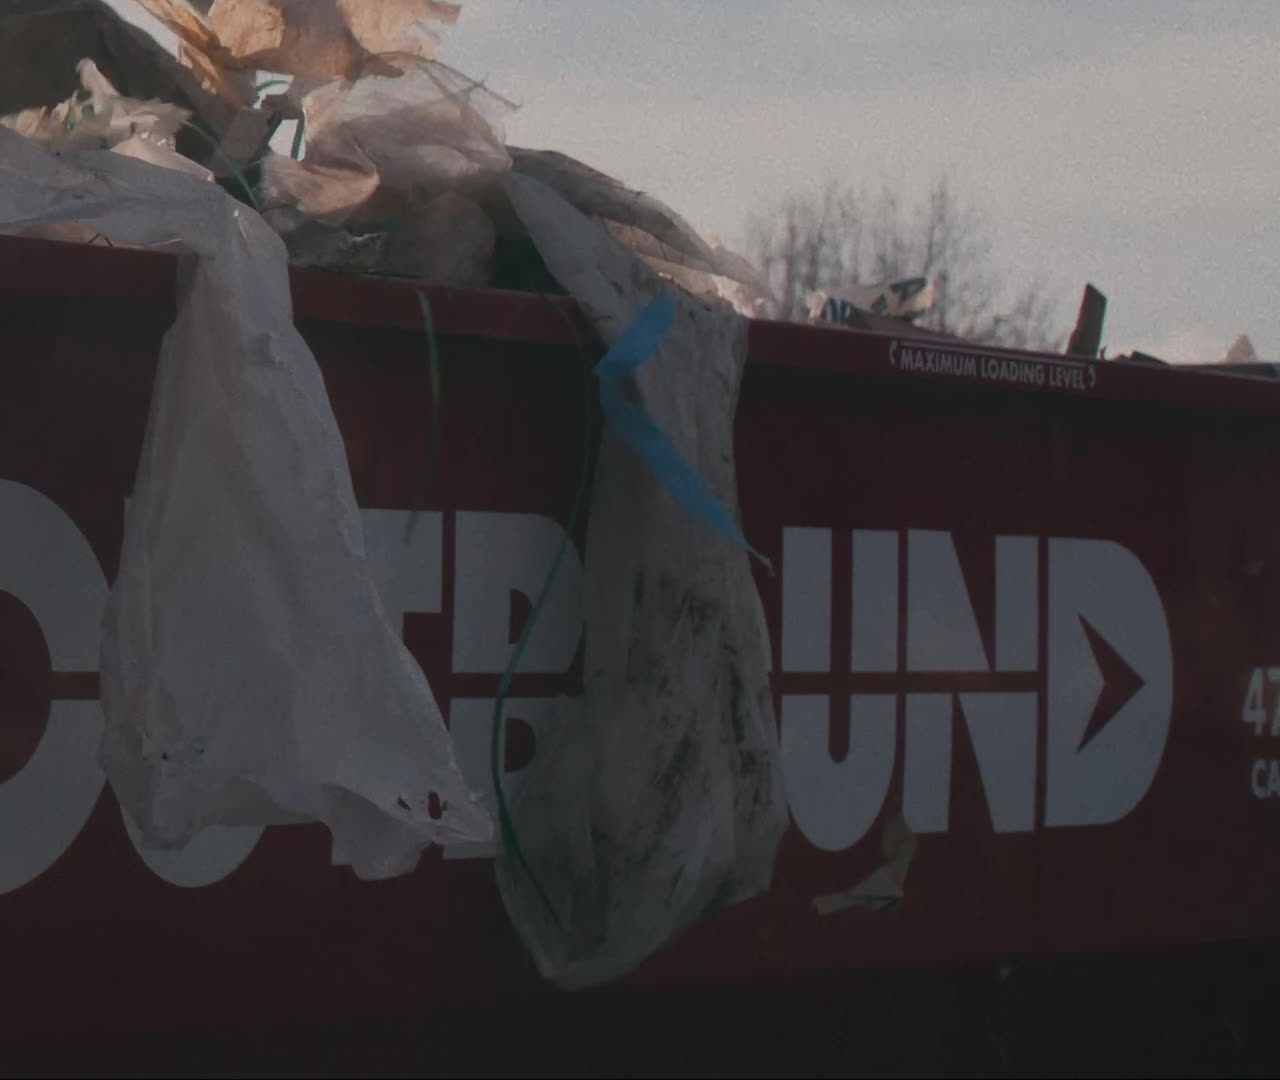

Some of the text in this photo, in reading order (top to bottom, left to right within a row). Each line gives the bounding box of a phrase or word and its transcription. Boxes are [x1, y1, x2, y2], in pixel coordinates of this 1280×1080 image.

[900, 349, 1086, 390] MAXIMUM LOADING LEVEL
